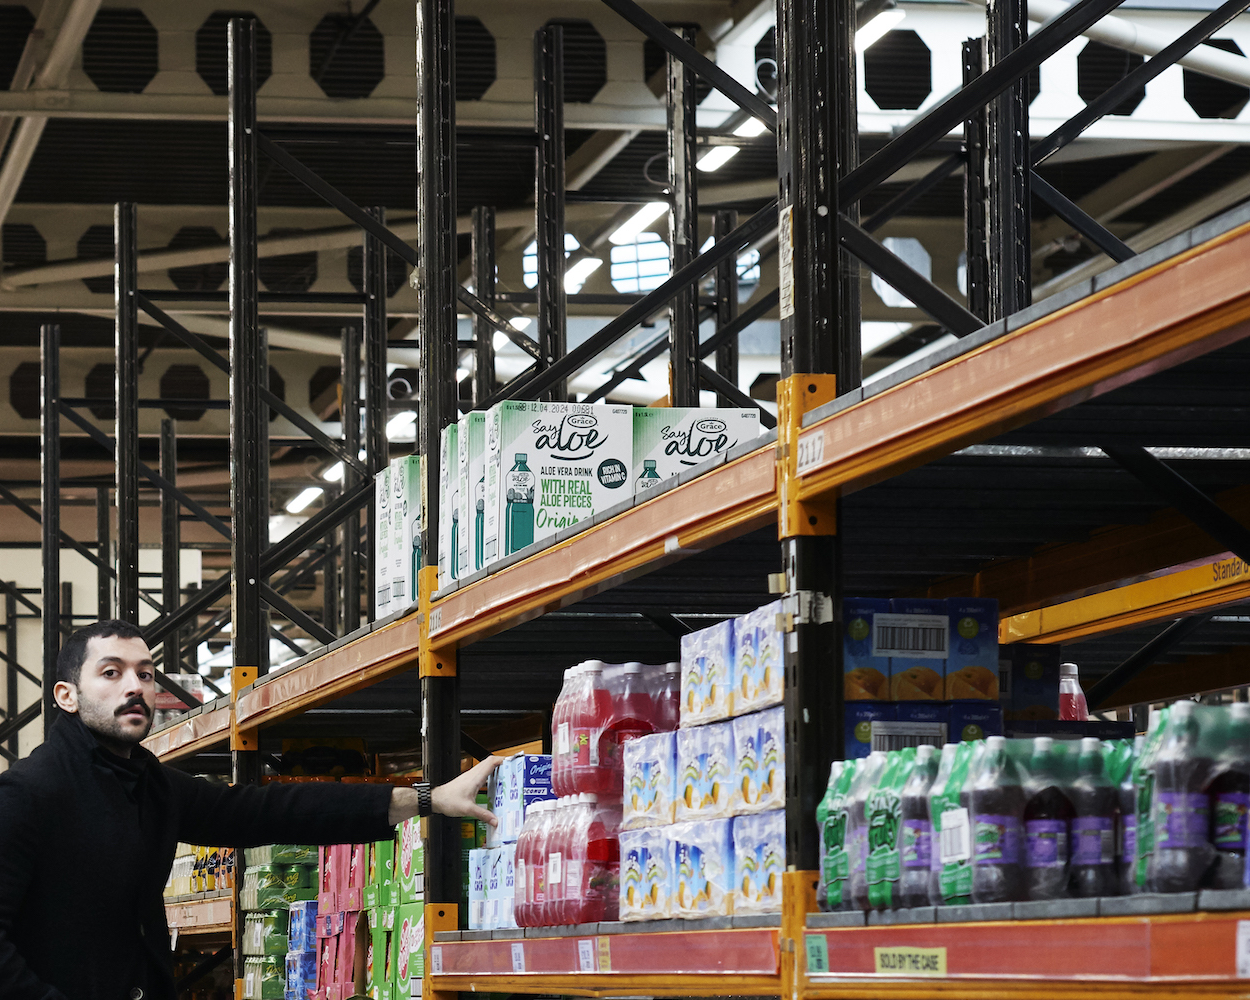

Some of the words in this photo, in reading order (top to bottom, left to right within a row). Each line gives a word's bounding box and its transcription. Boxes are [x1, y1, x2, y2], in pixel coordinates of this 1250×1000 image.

[532, 420, 559, 440] Say
[535, 414, 609, 451] aloe
[661, 426, 688, 445] Say
[798, 437, 824, 468] 2117
[541, 467, 556, 475] ALOE
[557, 467, 573, 476] VERA
[575, 468, 593, 477] DRINK
[541, 479, 565, 494] WITH
[568, 480, 592, 494] REAL
[540, 495, 561, 507] ALOE
[564, 495, 592, 508] PIECES
[880, 953, 897, 969] SOLD
